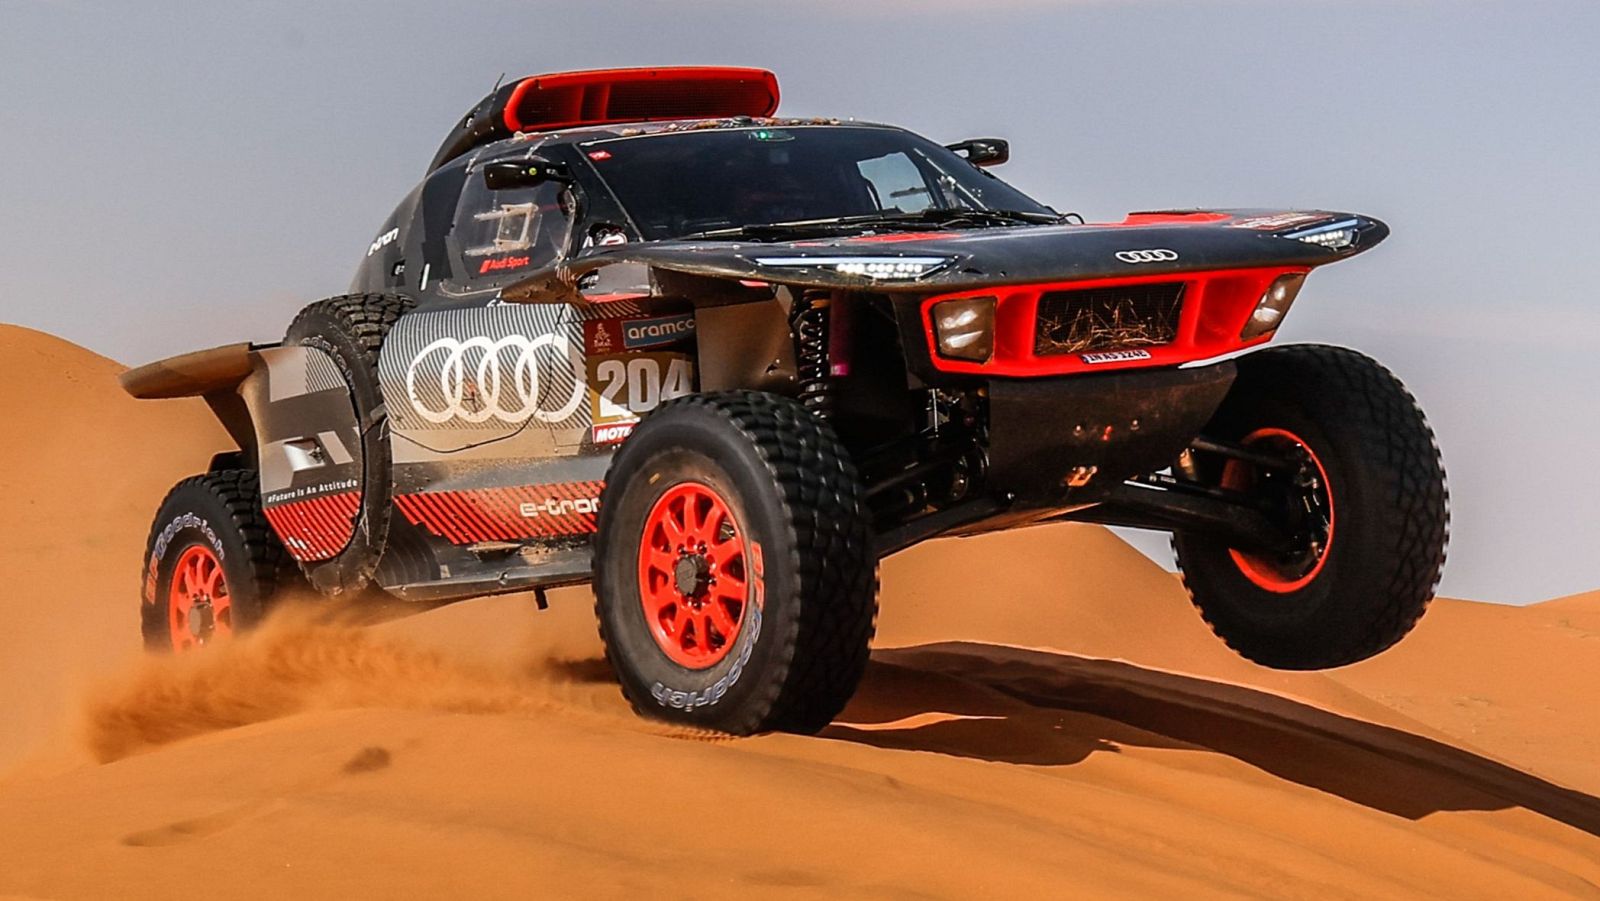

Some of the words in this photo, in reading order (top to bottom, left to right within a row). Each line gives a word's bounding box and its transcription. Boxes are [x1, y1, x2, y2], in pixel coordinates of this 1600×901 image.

[489, 258, 508, 270] Audi
[507, 256, 530, 270] Sport
[596, 358, 694, 417] 204
[319, 479, 358, 492] Attitude
